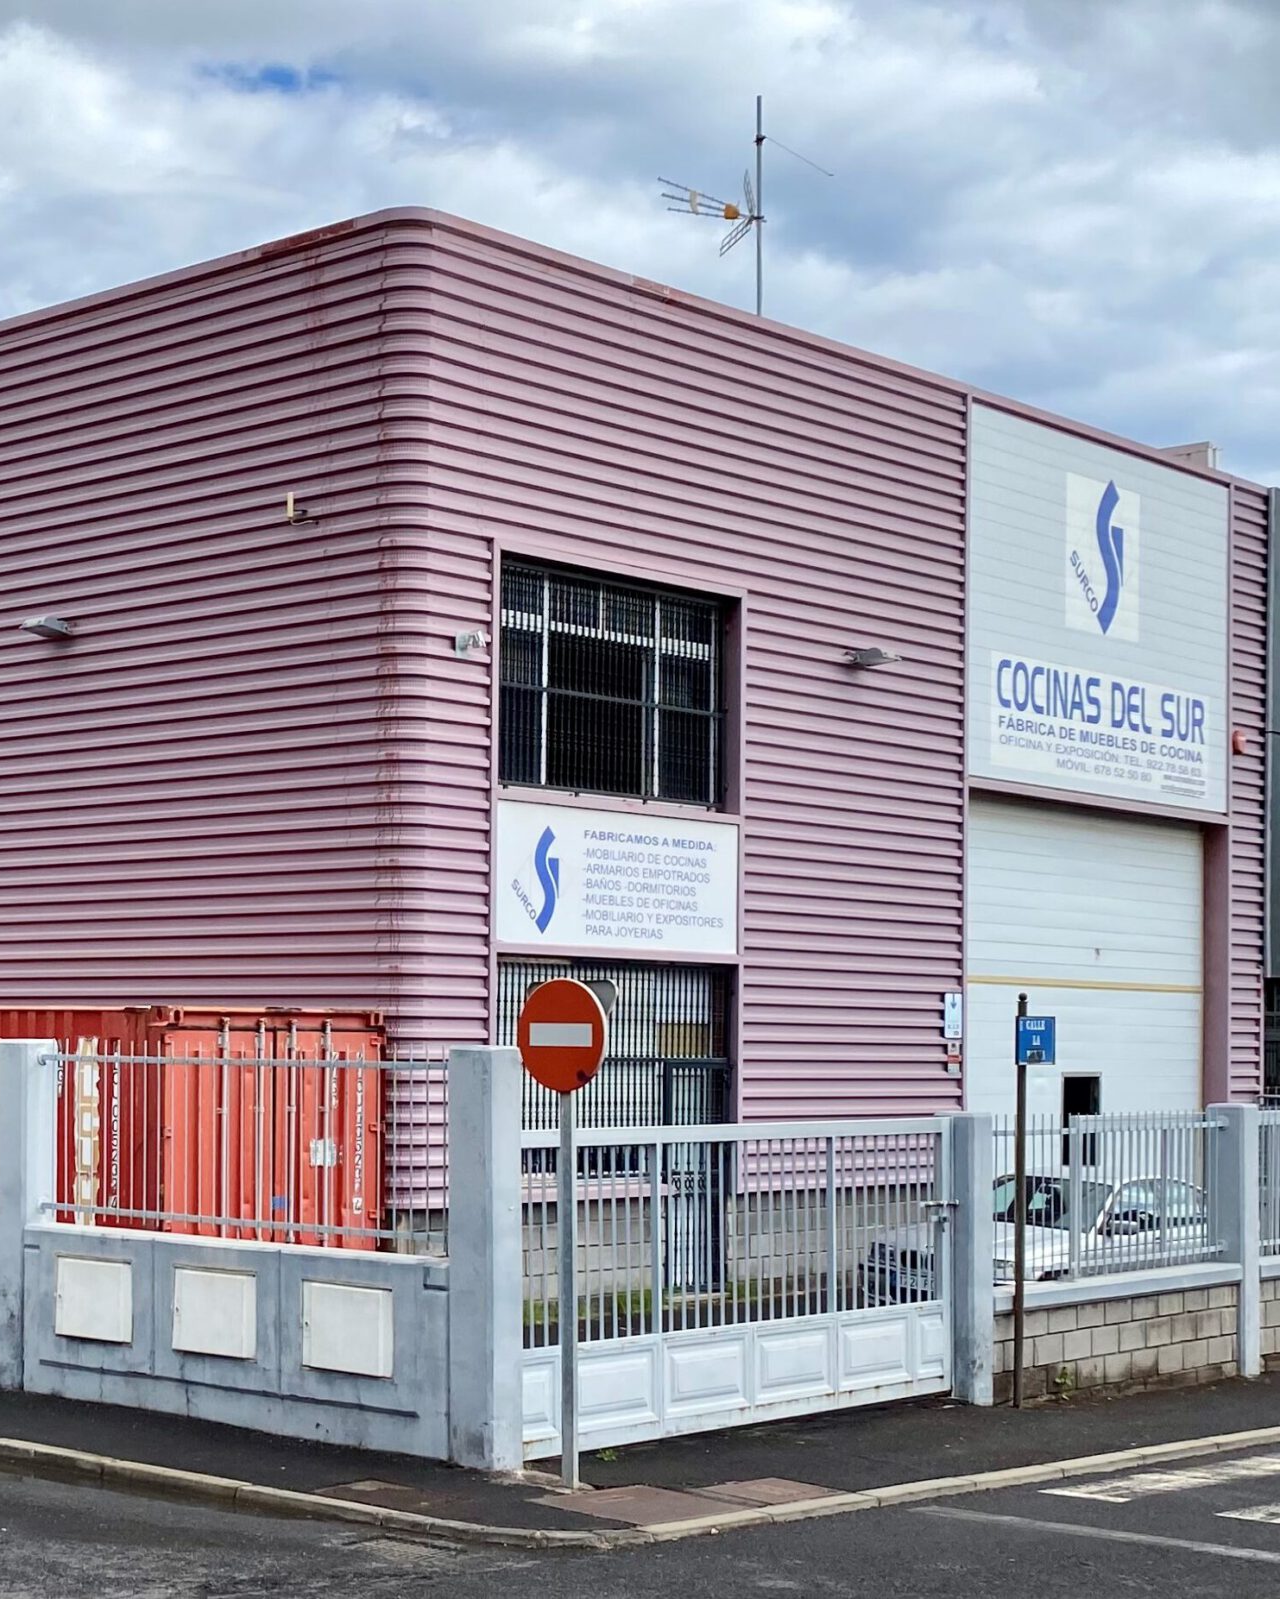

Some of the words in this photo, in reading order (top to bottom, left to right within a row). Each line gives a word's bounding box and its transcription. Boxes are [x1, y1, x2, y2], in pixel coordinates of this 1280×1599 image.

[1069, 551, 1098, 613] SURCO
[996, 658, 1100, 724] COCINAS
[1111, 681, 1152, 735] DEL
[1161, 693, 1205, 745] SUR
[998, 714, 1055, 738] FÁBRICA
[1059, 727, 1075, 740] DE
[1080, 730, 1137, 751] MUEBLES
[1141, 741, 1156, 755] DE
[1160, 744, 1203, 764] COCINA
[999, 734, 1045, 750] OFICINA
[1045, 742, 1053, 752] Y
[584, 830, 659, 847] FABRICAMOS
[662, 836, 670, 848] A
[648, 852, 661, 865] DE
[663, 855, 707, 869] COCINAS
[642, 868, 711, 884] EMPOTRADOS
[511, 879, 537, 920] SURCO
[637, 896, 650, 909] DE
[652, 898, 698, 912] OFICINAS
[647, 911, 654, 924] Y
[656, 912, 724, 929] EXPOSITORES
[585, 923, 612, 937] PARA
[615, 925, 664, 940] JOYERIAS
